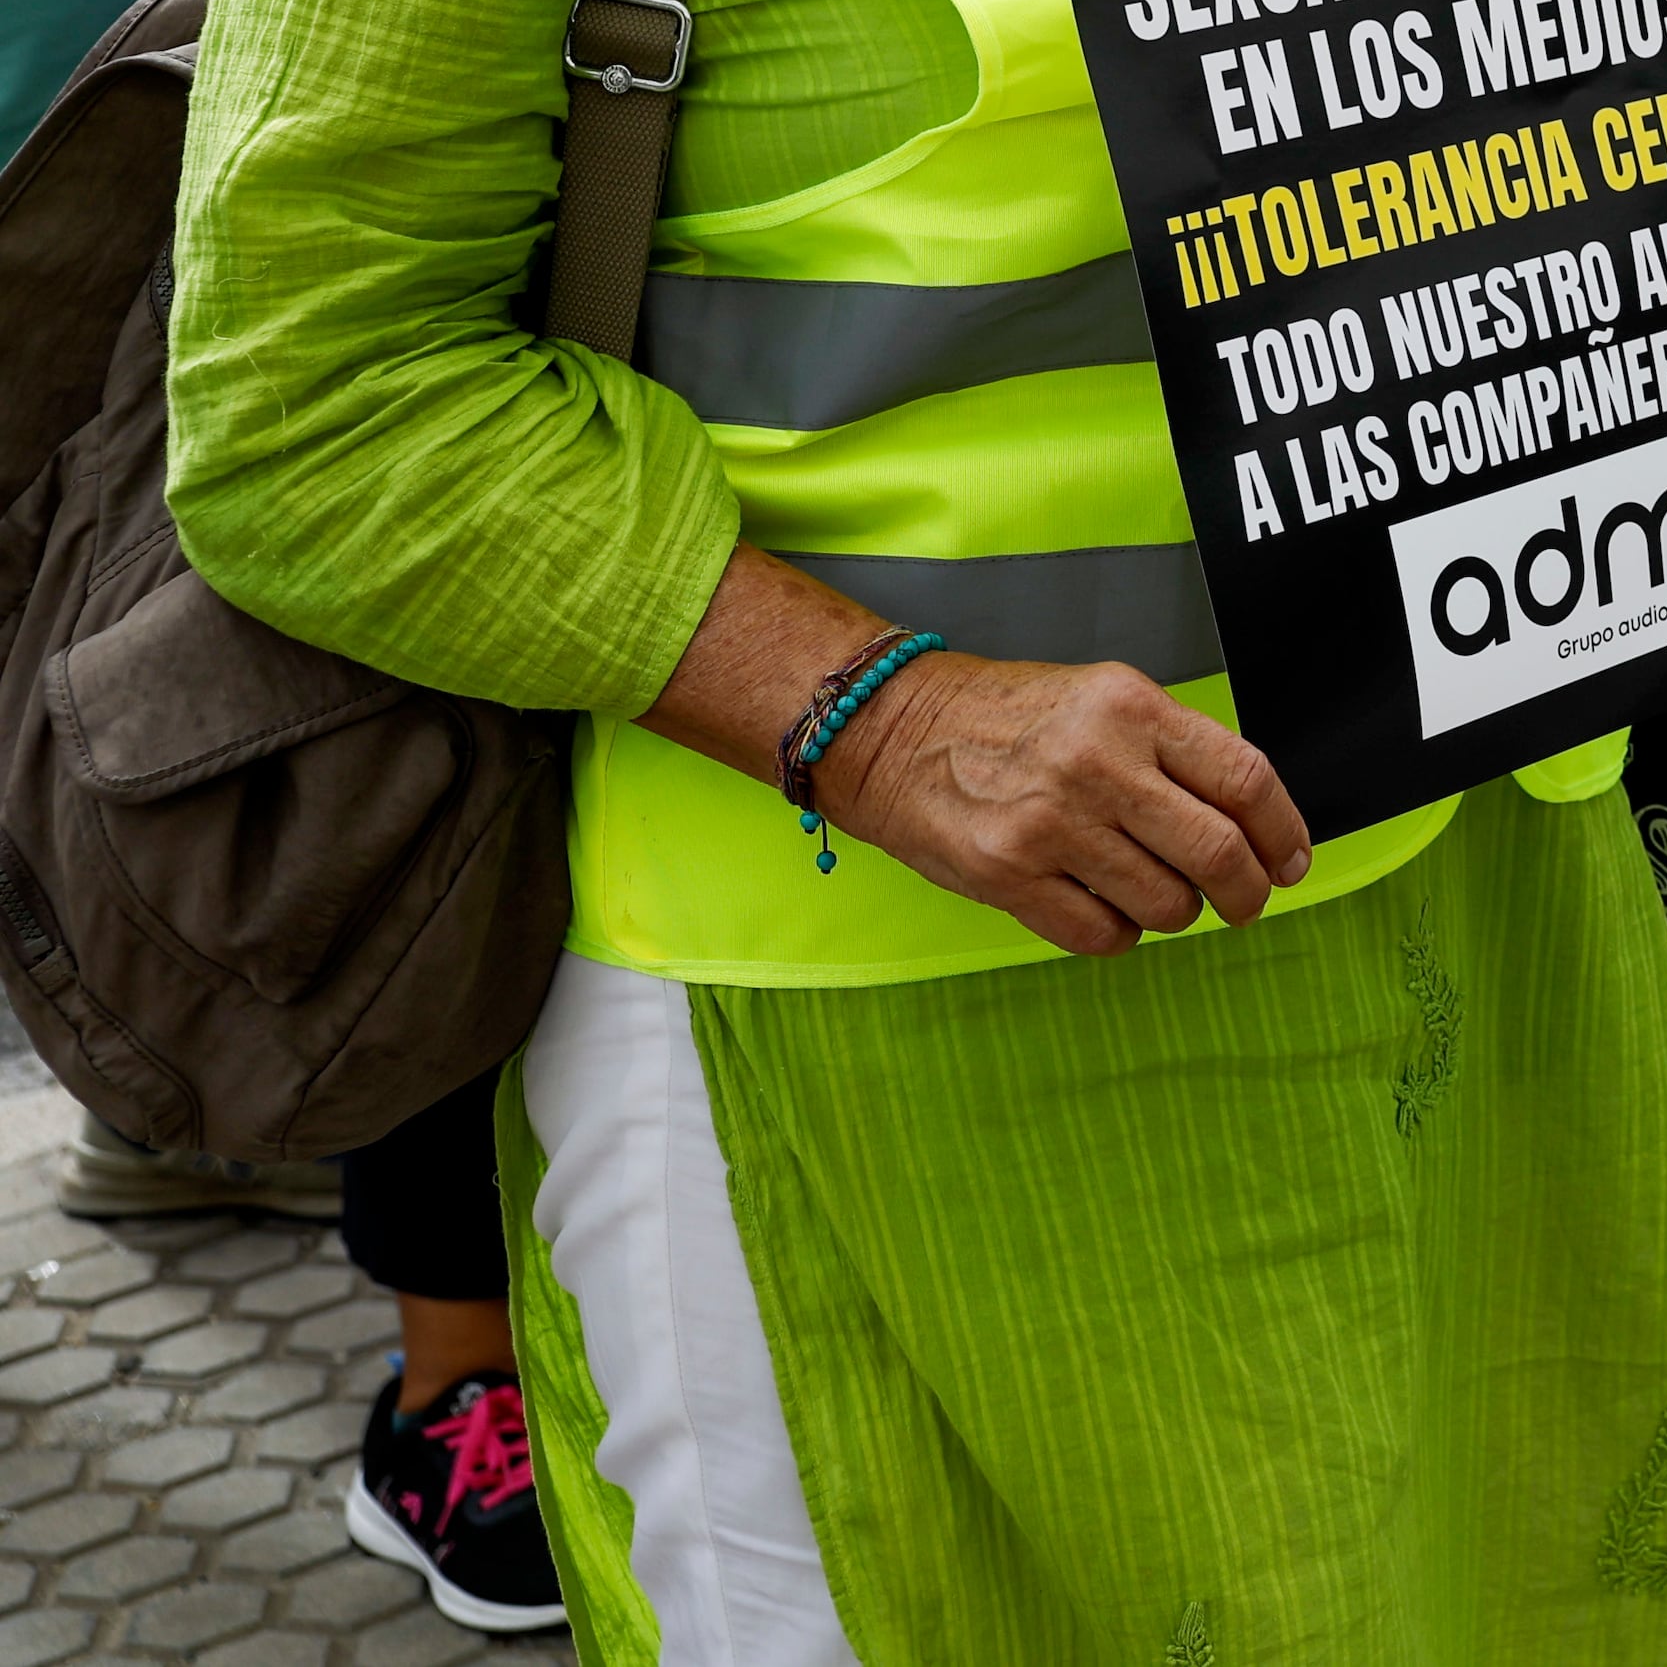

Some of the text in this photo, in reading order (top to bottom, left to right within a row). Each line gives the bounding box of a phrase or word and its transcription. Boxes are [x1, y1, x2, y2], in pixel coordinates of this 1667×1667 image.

[1199, 38, 1304, 156] EN
[1310, 9, 1444, 131] LOS
[1166, 119, 1589, 309] ¡¡¡TOLERANCIA
[1216, 306, 1375, 425] TODO
[1380, 240, 1621, 380] NUESTRO
[1233, 450, 1283, 542] A
[1287, 414, 1400, 525] LAS
[1557, 625, 1614, 661] Grupo
